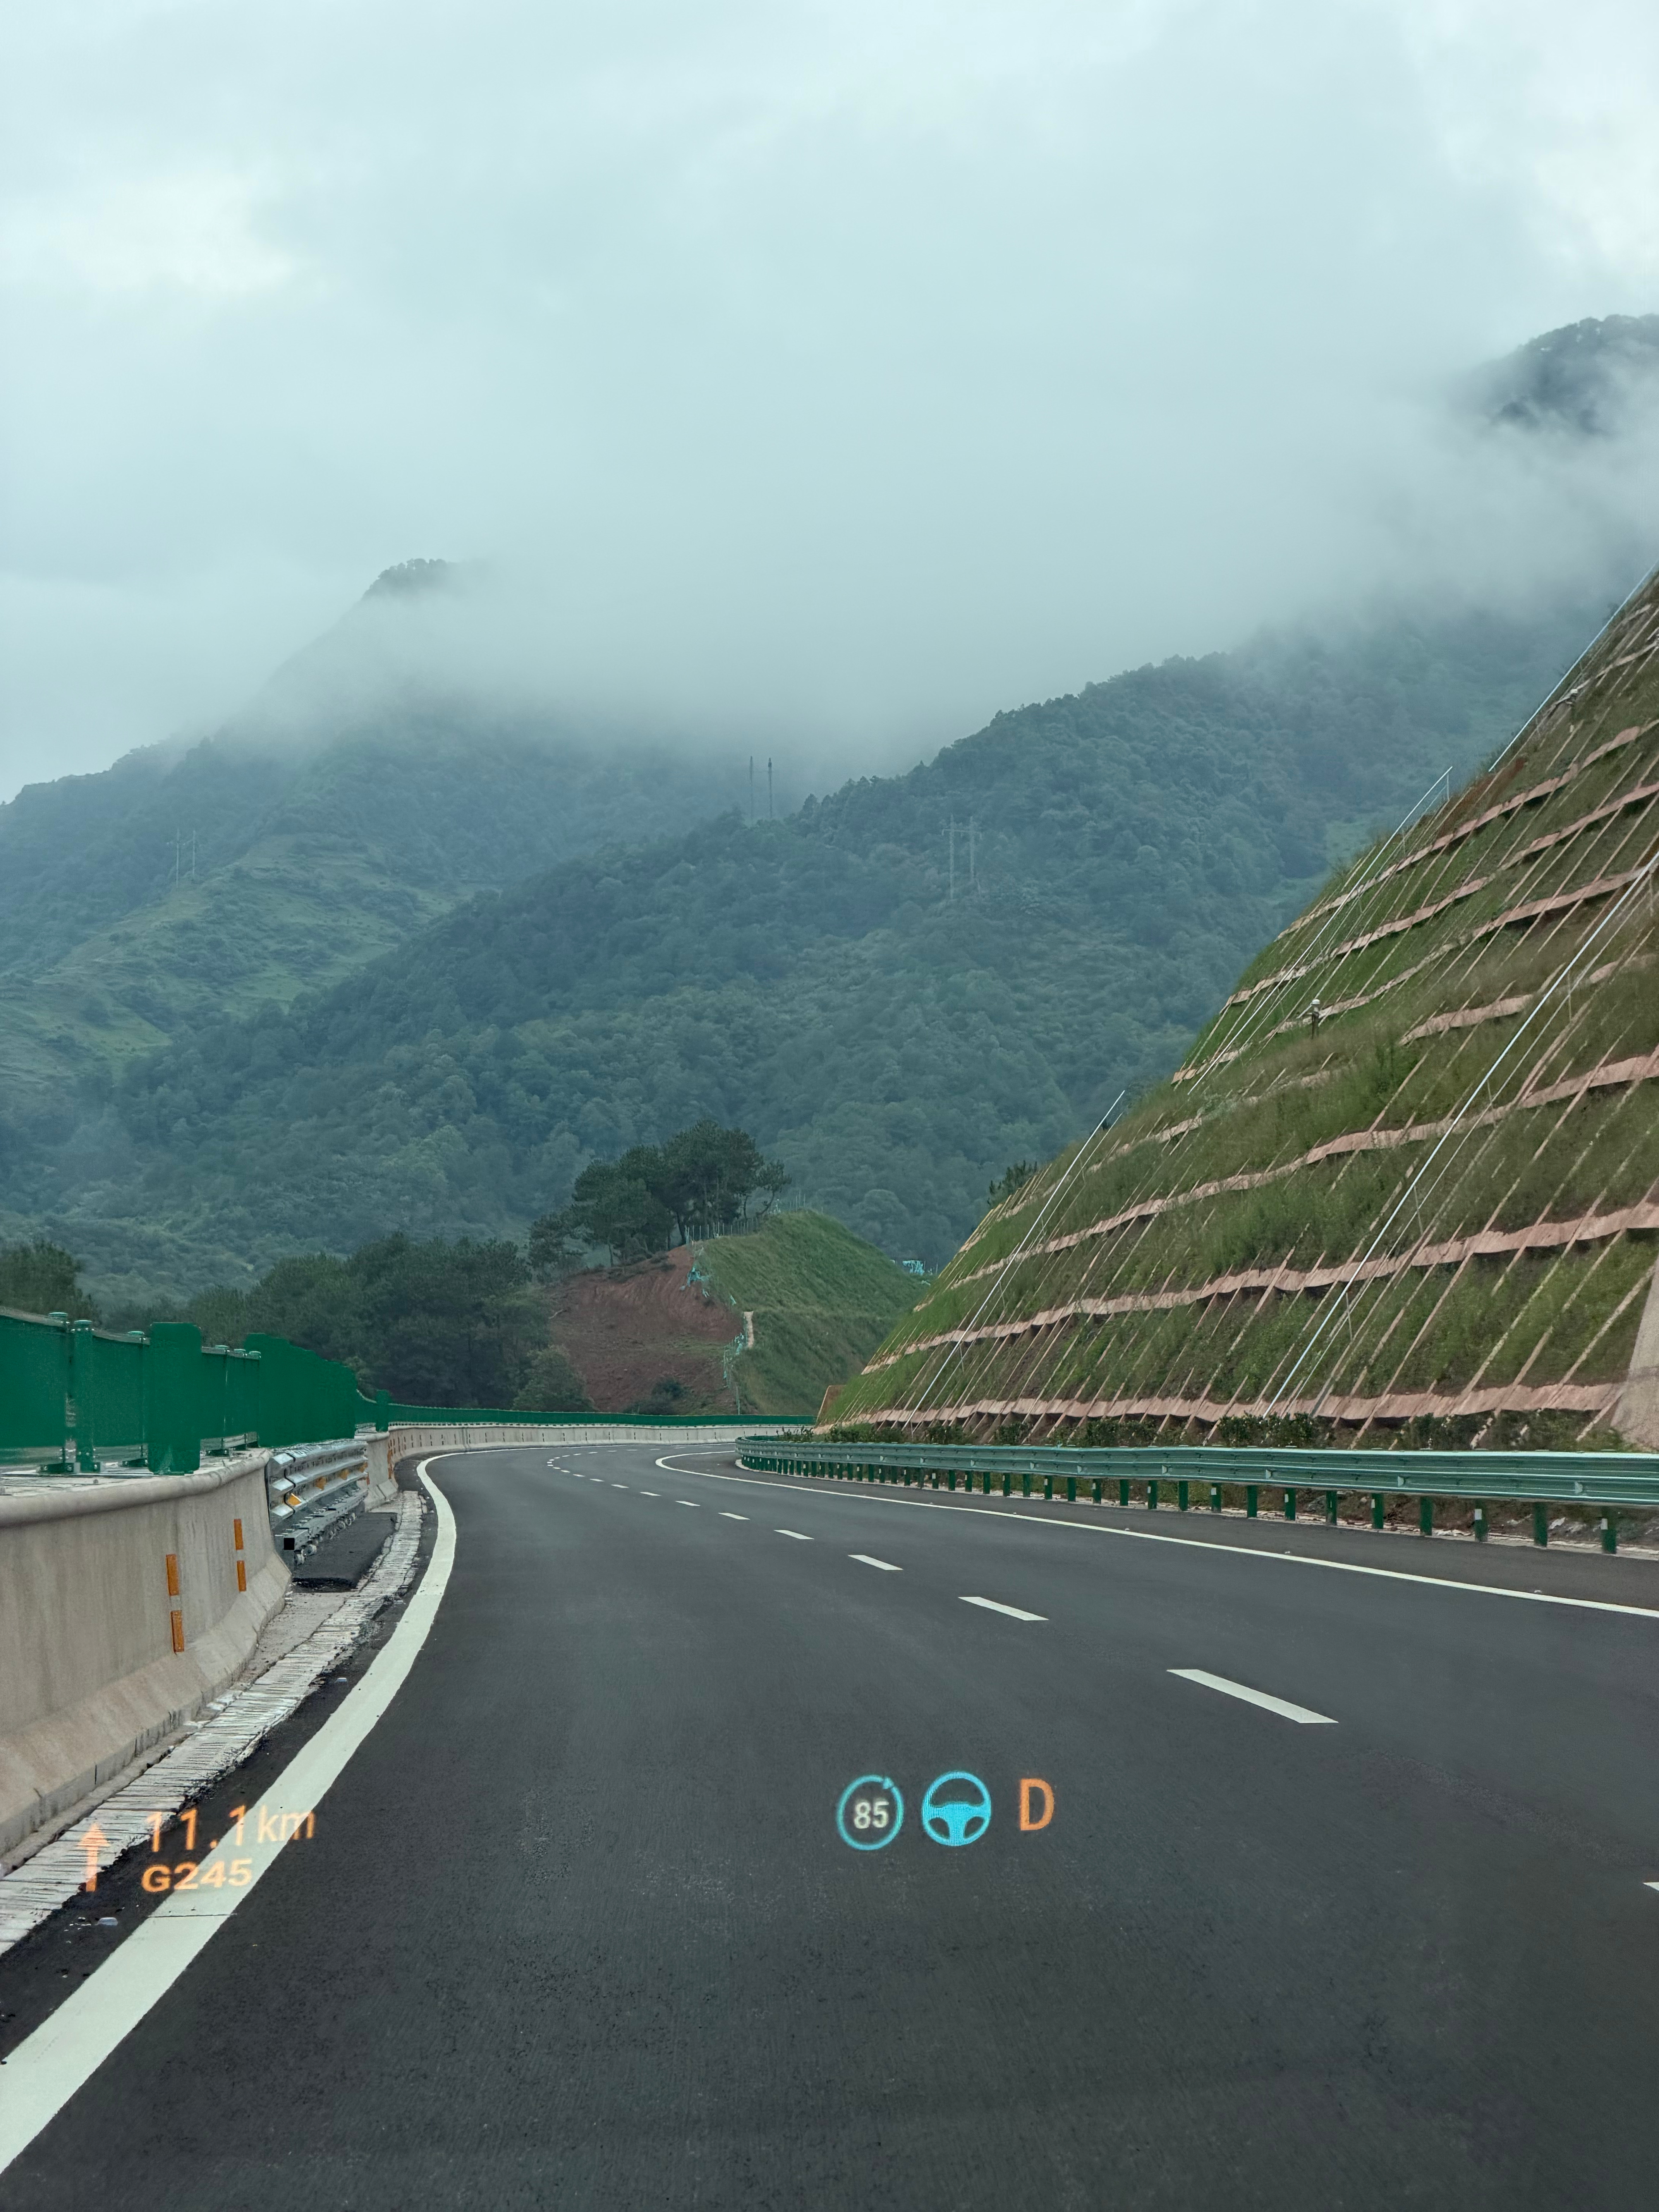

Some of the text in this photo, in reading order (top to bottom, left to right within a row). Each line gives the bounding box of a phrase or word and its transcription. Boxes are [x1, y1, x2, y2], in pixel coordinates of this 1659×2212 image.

[854, 1778, 1055, 1831] 85 D
[141, 1858, 253, 1893] G245
